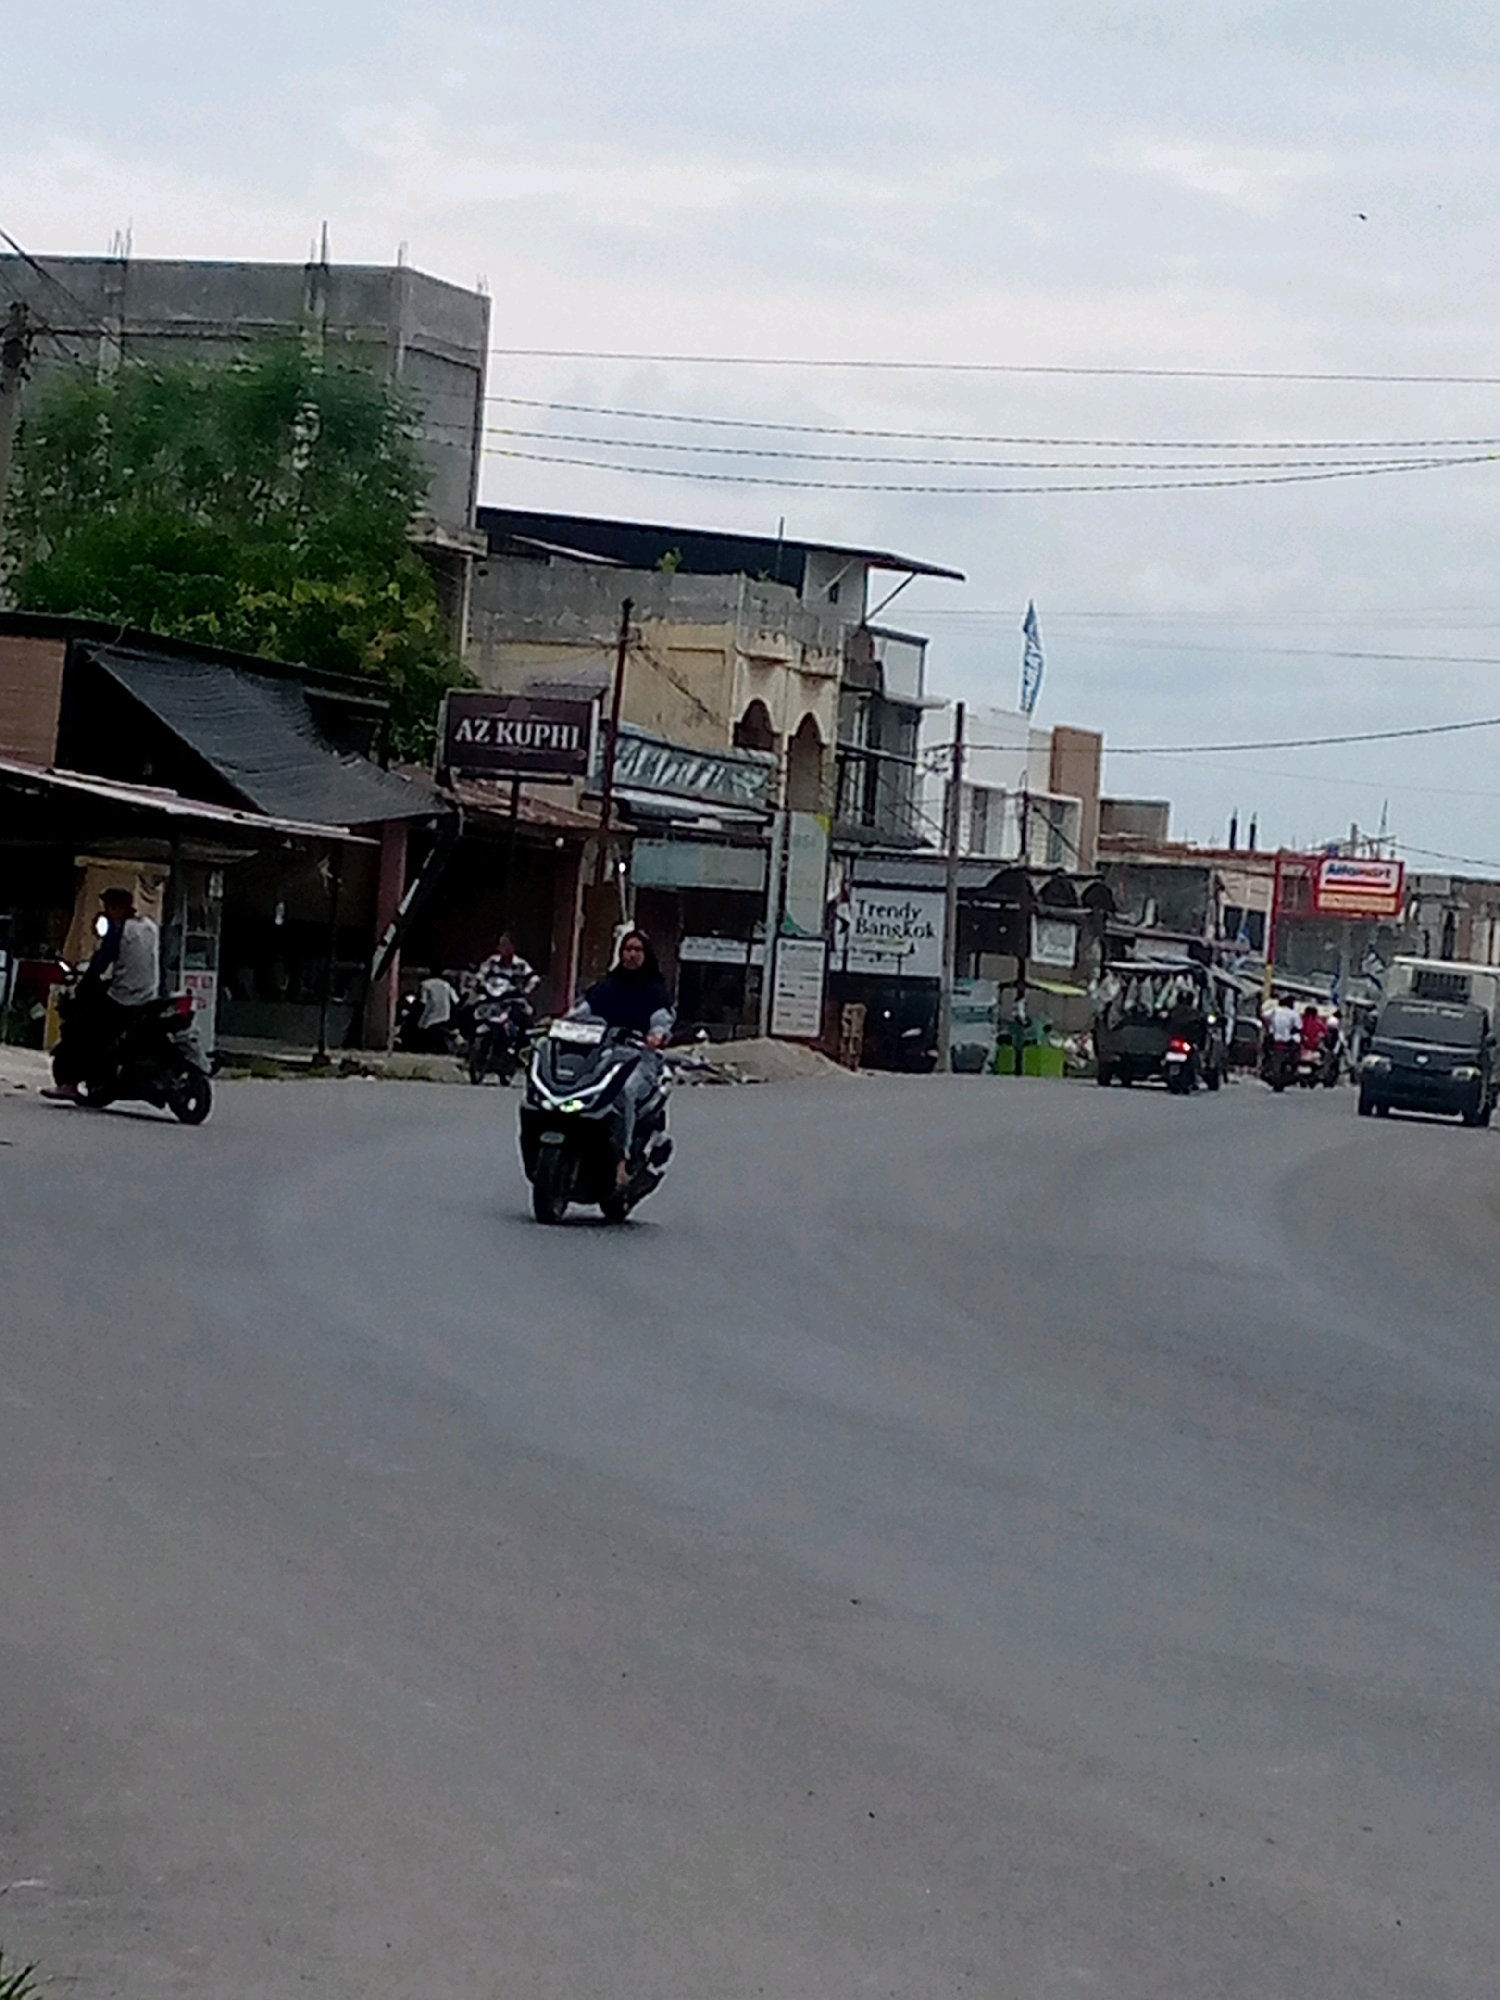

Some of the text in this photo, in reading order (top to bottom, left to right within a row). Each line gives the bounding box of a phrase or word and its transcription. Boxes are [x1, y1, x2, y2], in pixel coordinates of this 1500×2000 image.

[454, 718, 580, 750] AZ KUPHI
[855, 899, 922, 919] Trendy
[856, 917, 935, 939] Bangkok
